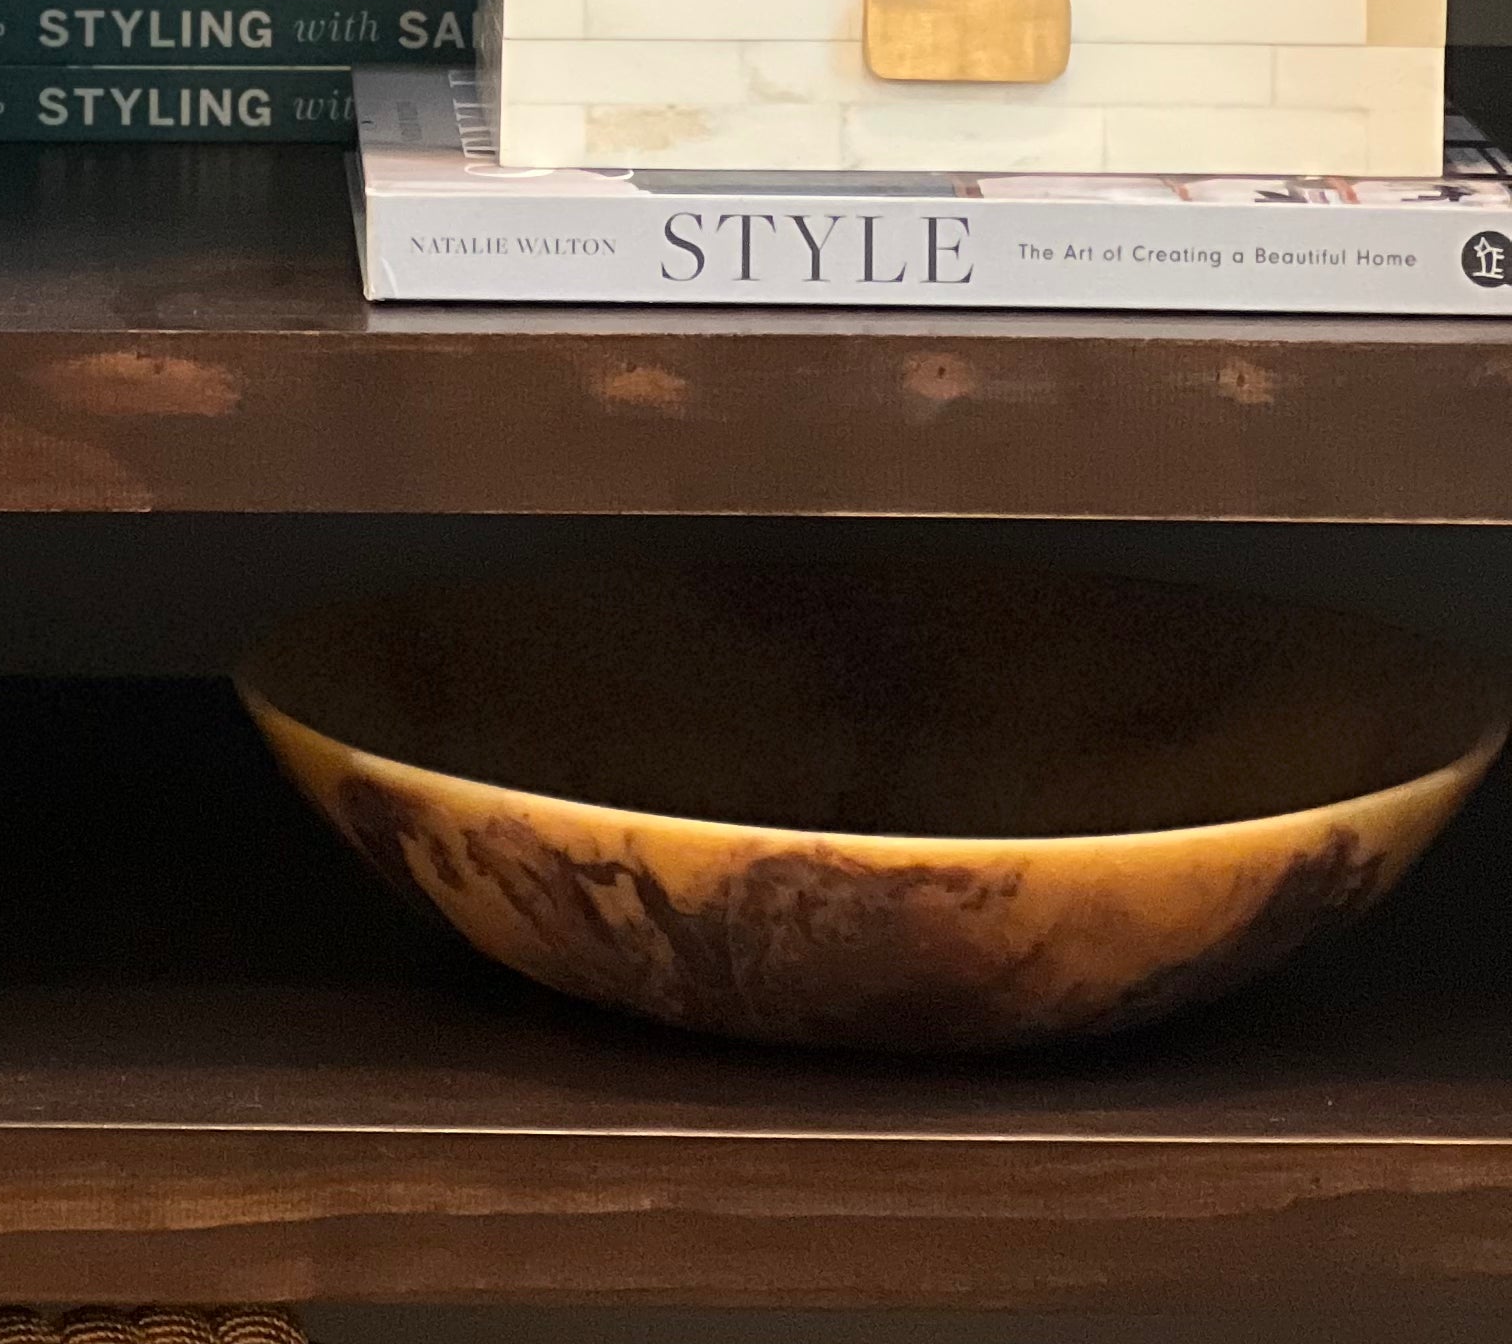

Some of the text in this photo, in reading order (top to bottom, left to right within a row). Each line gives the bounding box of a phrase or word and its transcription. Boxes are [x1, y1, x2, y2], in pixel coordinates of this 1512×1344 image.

[38, 9, 274, 49] STYLING
[294, 11, 380, 43] with
[398, 10, 472, 50] SA
[37, 87, 273, 127] STYLING
[293, 89, 354, 121] wit
[410, 211, 1418, 285] NATALIE WALTON STYLE The Art of Creating a Beautiful Home
